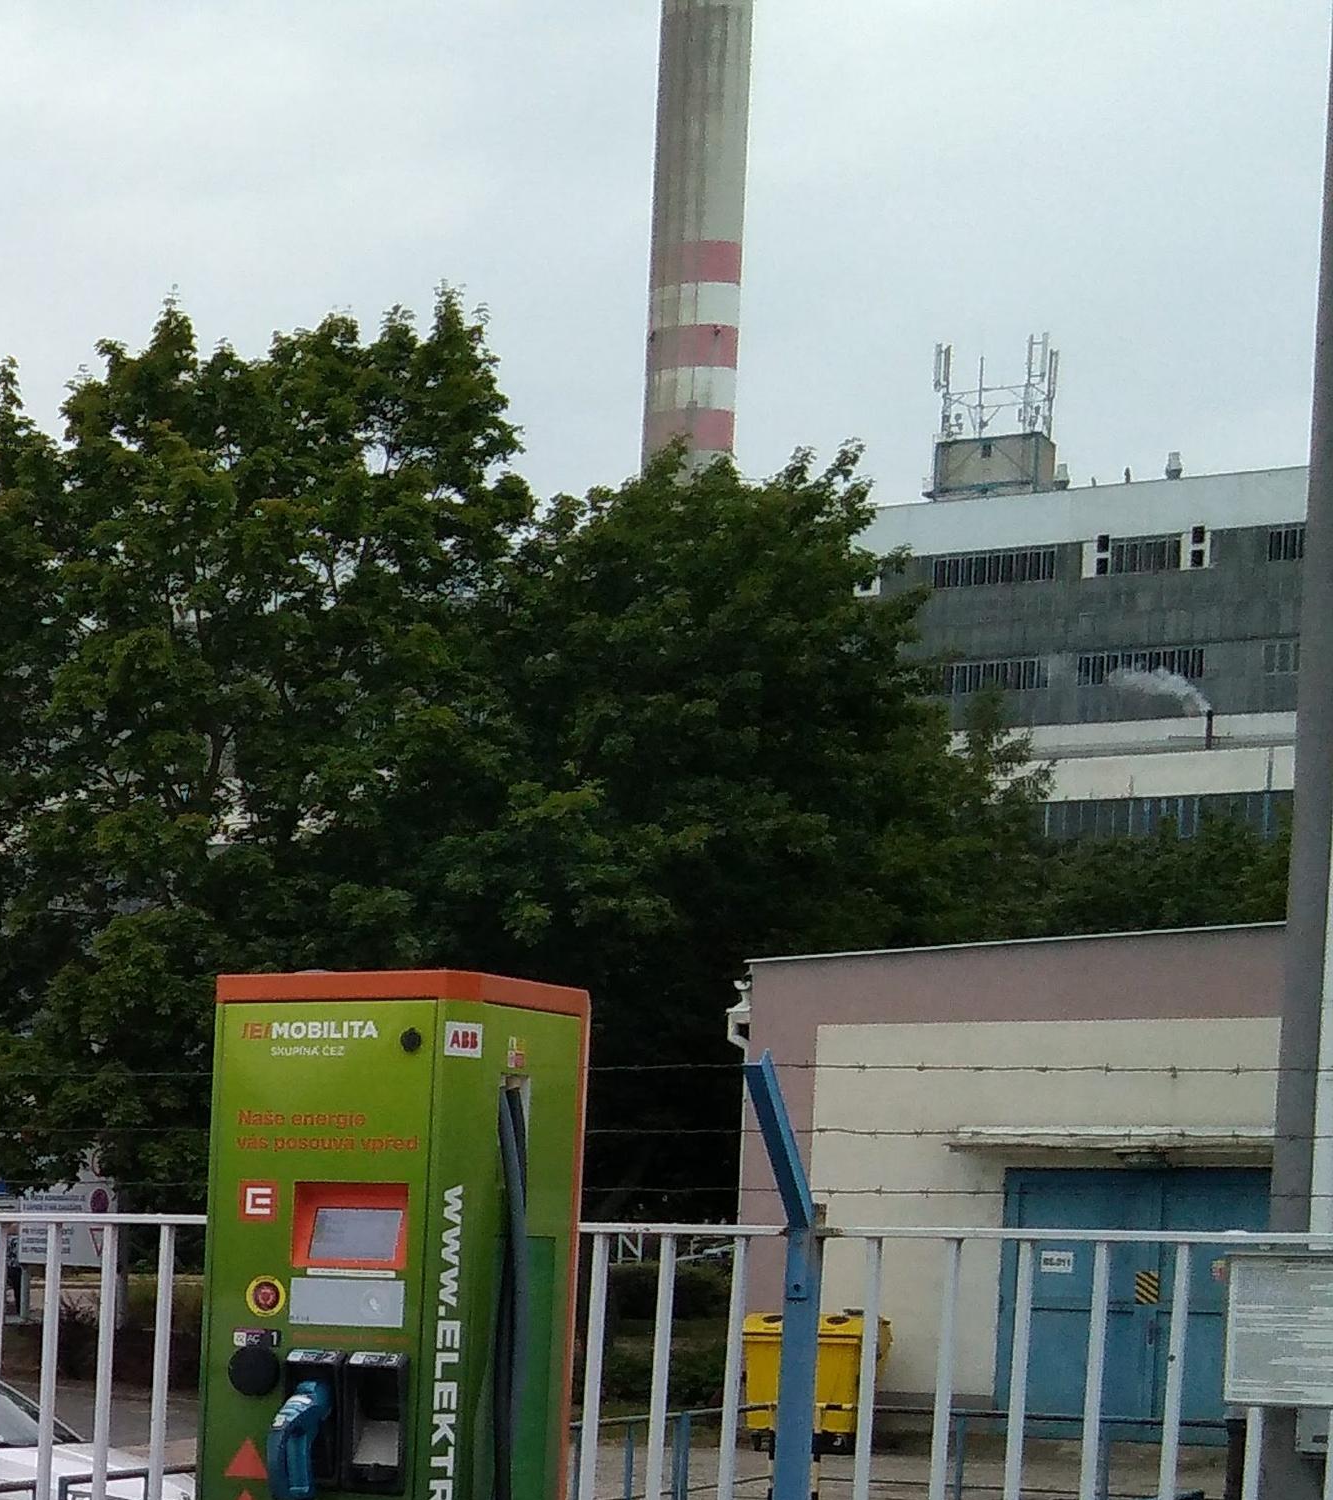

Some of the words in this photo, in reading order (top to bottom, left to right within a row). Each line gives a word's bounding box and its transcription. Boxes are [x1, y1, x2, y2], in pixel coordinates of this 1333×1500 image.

[450, 1029, 479, 1050] ABB
[270, 1046, 319, 1057] SKUPINA
[291, 1110, 366, 1129] energie
[270, 1331, 278, 1346] 1
